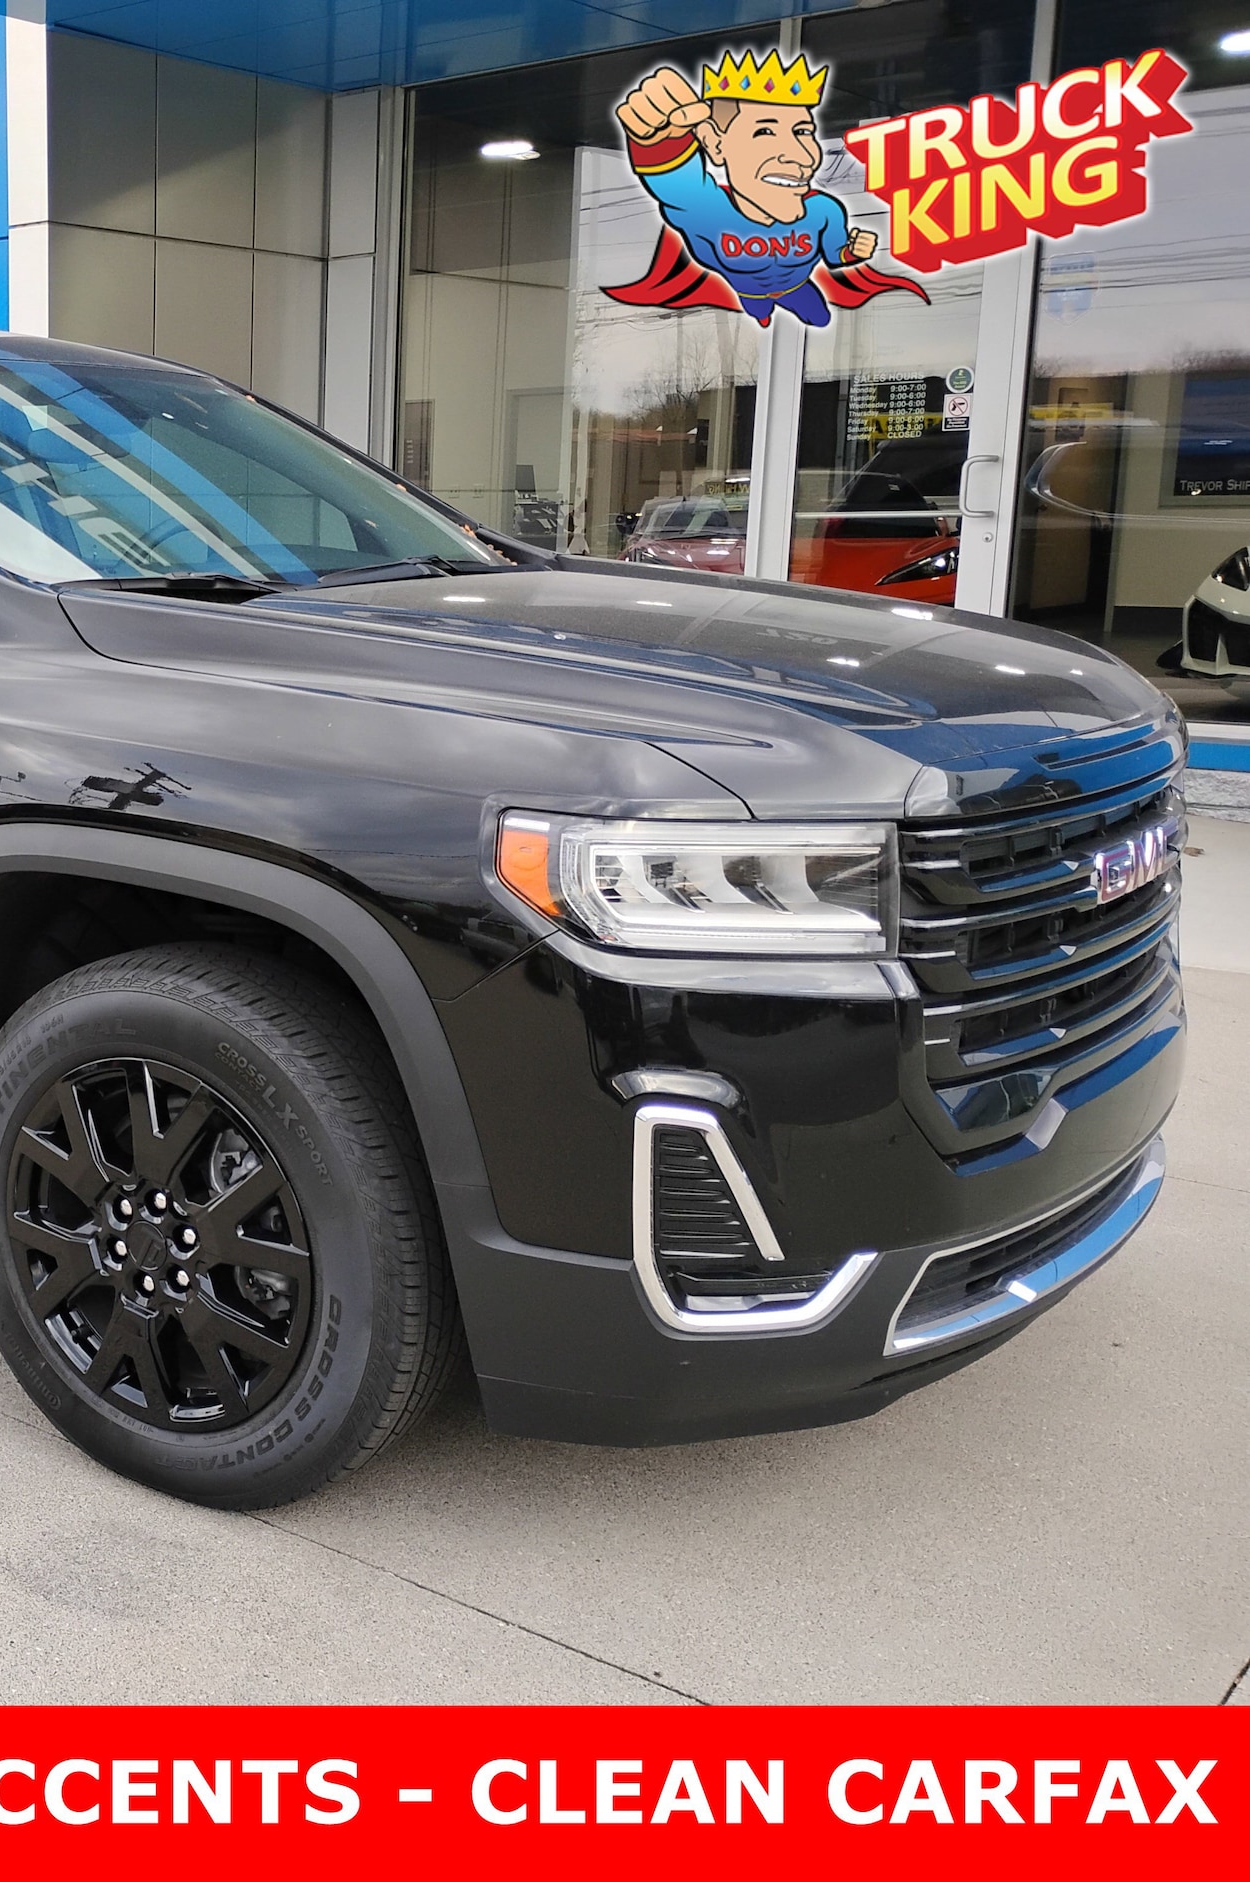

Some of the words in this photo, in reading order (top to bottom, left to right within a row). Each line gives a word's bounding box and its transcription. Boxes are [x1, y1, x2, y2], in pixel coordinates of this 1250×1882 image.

[853, 374, 887, 384] SALES
[889, 371, 924, 381] HOURS
[850, 387, 877, 395] Monday
[849, 402, 888, 410] Wednesday
[887, 431, 922, 439] CLOSED
[1180, 480, 1223, 491] TREVOR
[218, 1042, 267, 1087] CROSS
[295, 1125, 334, 1187] SPORT
[294, 1294, 342, 1422] CROSS
